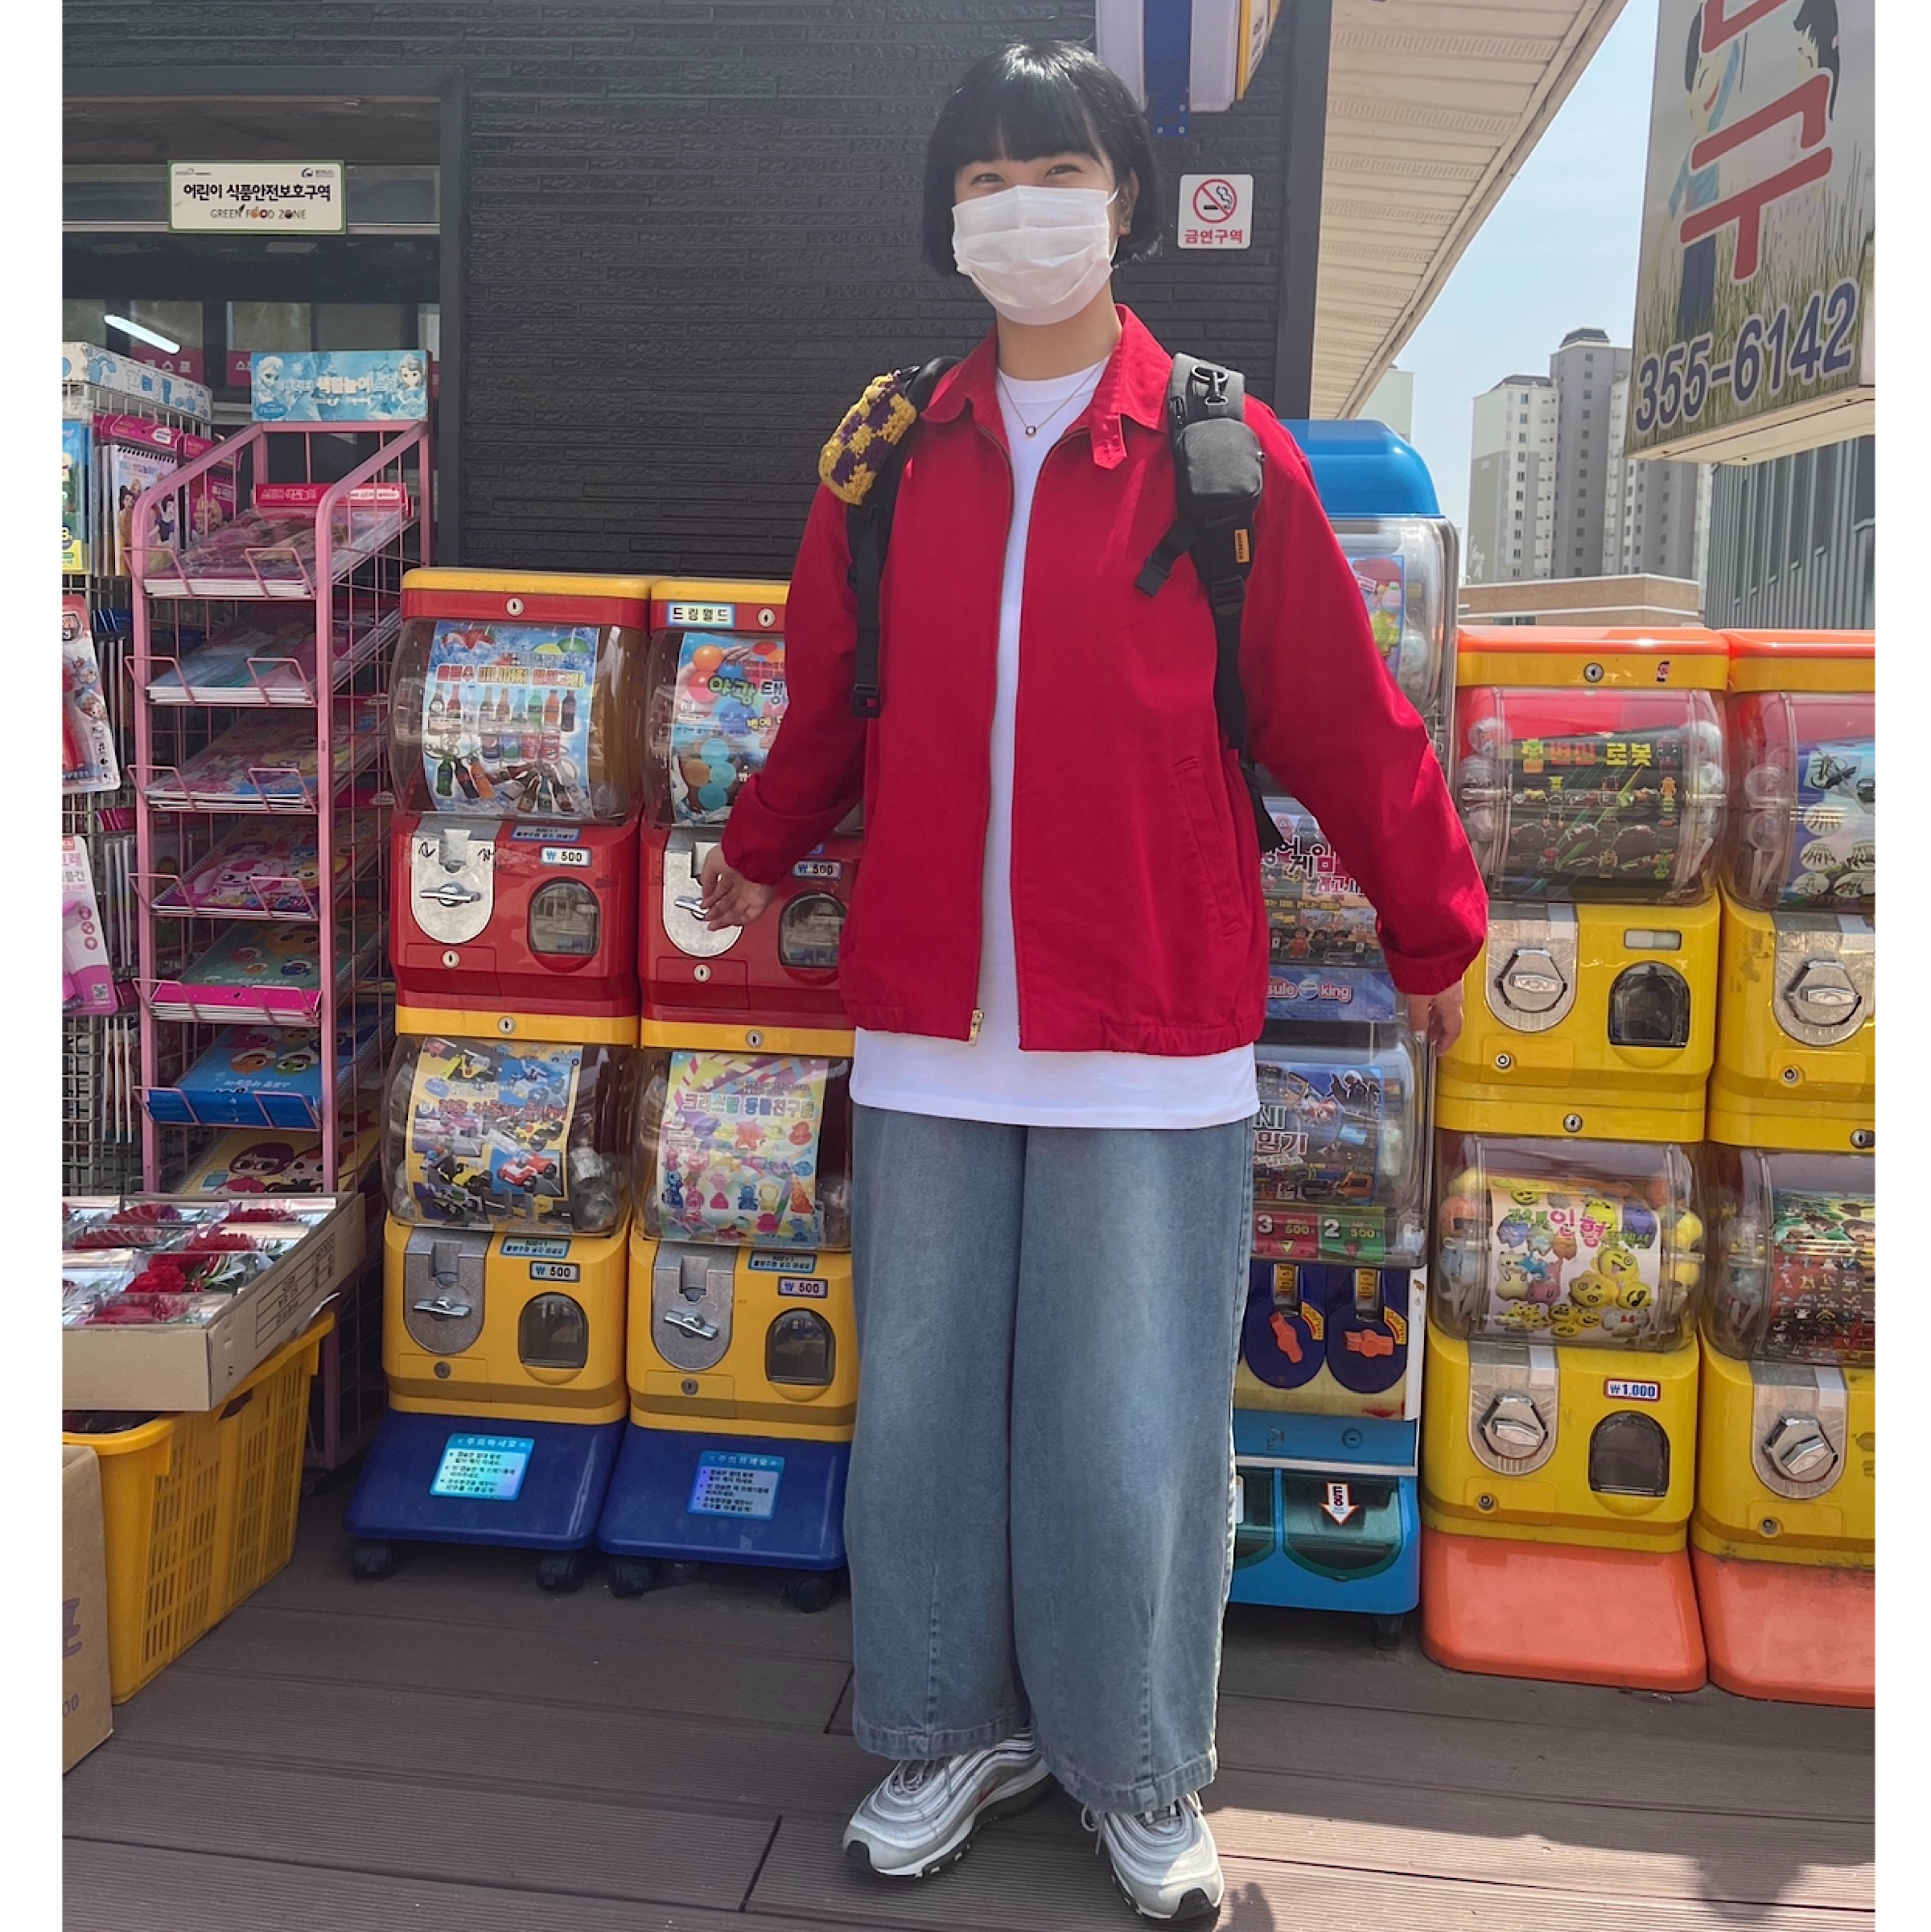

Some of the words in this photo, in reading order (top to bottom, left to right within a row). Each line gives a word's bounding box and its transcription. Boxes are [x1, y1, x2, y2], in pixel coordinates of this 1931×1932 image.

[1679, 0, 1833, 282] 구
[183, 183, 223, 201] 어린이
[226, 183, 331, 202] 식품안전보호구역
[211, 209, 242, 220] GREEN
[245, 208, 275, 220] FOOD
[278, 209, 307, 220] ZONE
[1184, 229, 1244, 244] 금연구역
[1636, 282, 1857, 432] 355-6142
[673, 607, 728, 622] 드림월드
[760, 679, 786, 706] 탱
[1606, 742, 1652, 767] 로봇
[561, 851, 582, 863] 500
[812, 863, 834, 875] 500
[1267, 982, 1295, 997] sule
[1320, 982, 1351, 1001] king
[1258, 1213, 1273, 1234] 3
[1285, 1224, 1309, 1236] 500
[1324, 1217, 1340, 1238] 2
[1350, 1228, 1375, 1238] 500
[1550, 1208, 1607, 1248] 인형
[550, 1266, 571, 1278] 500
[799, 1282, 819, 1294] 500
